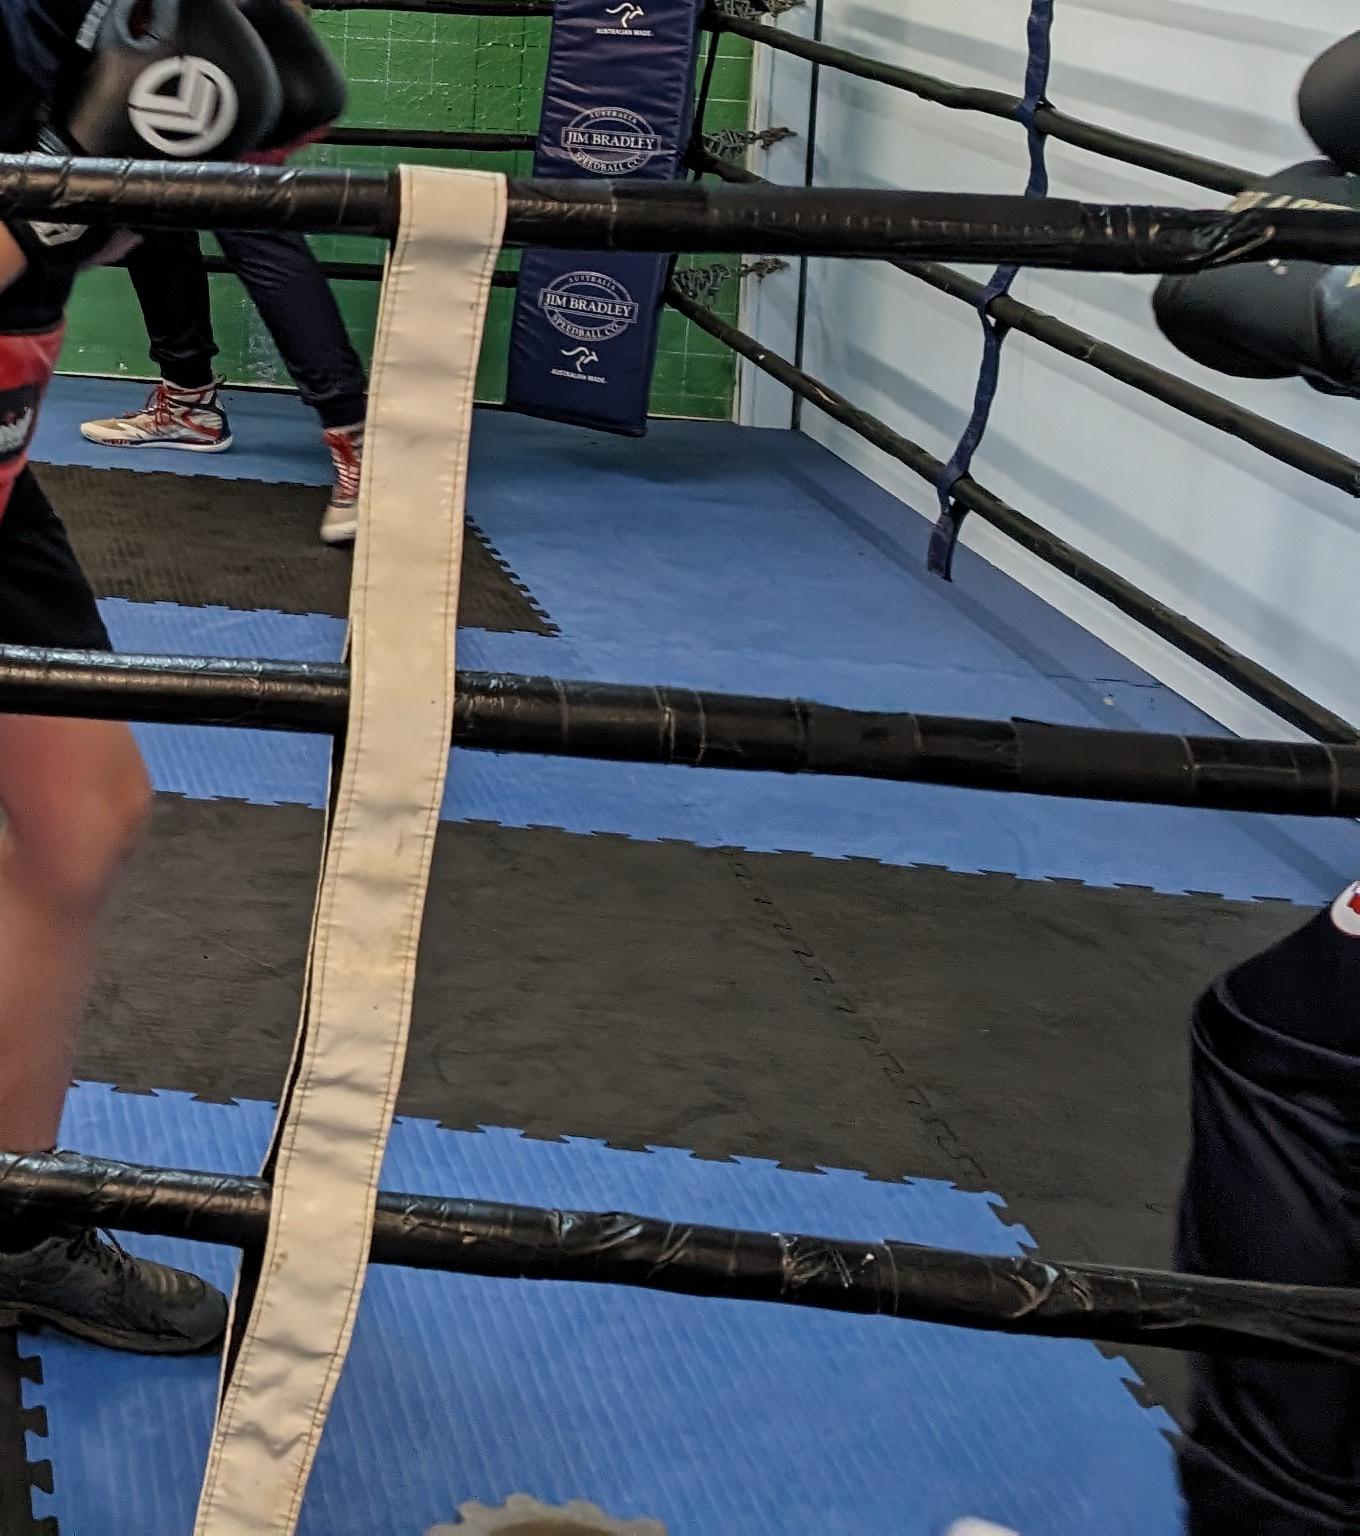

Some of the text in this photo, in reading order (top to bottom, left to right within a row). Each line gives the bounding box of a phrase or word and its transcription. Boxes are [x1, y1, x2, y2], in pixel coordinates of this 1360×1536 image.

[567, 131, 655, 150] JIM BRADLEY
[544, 293, 632, 317] JIM BRADLEY
